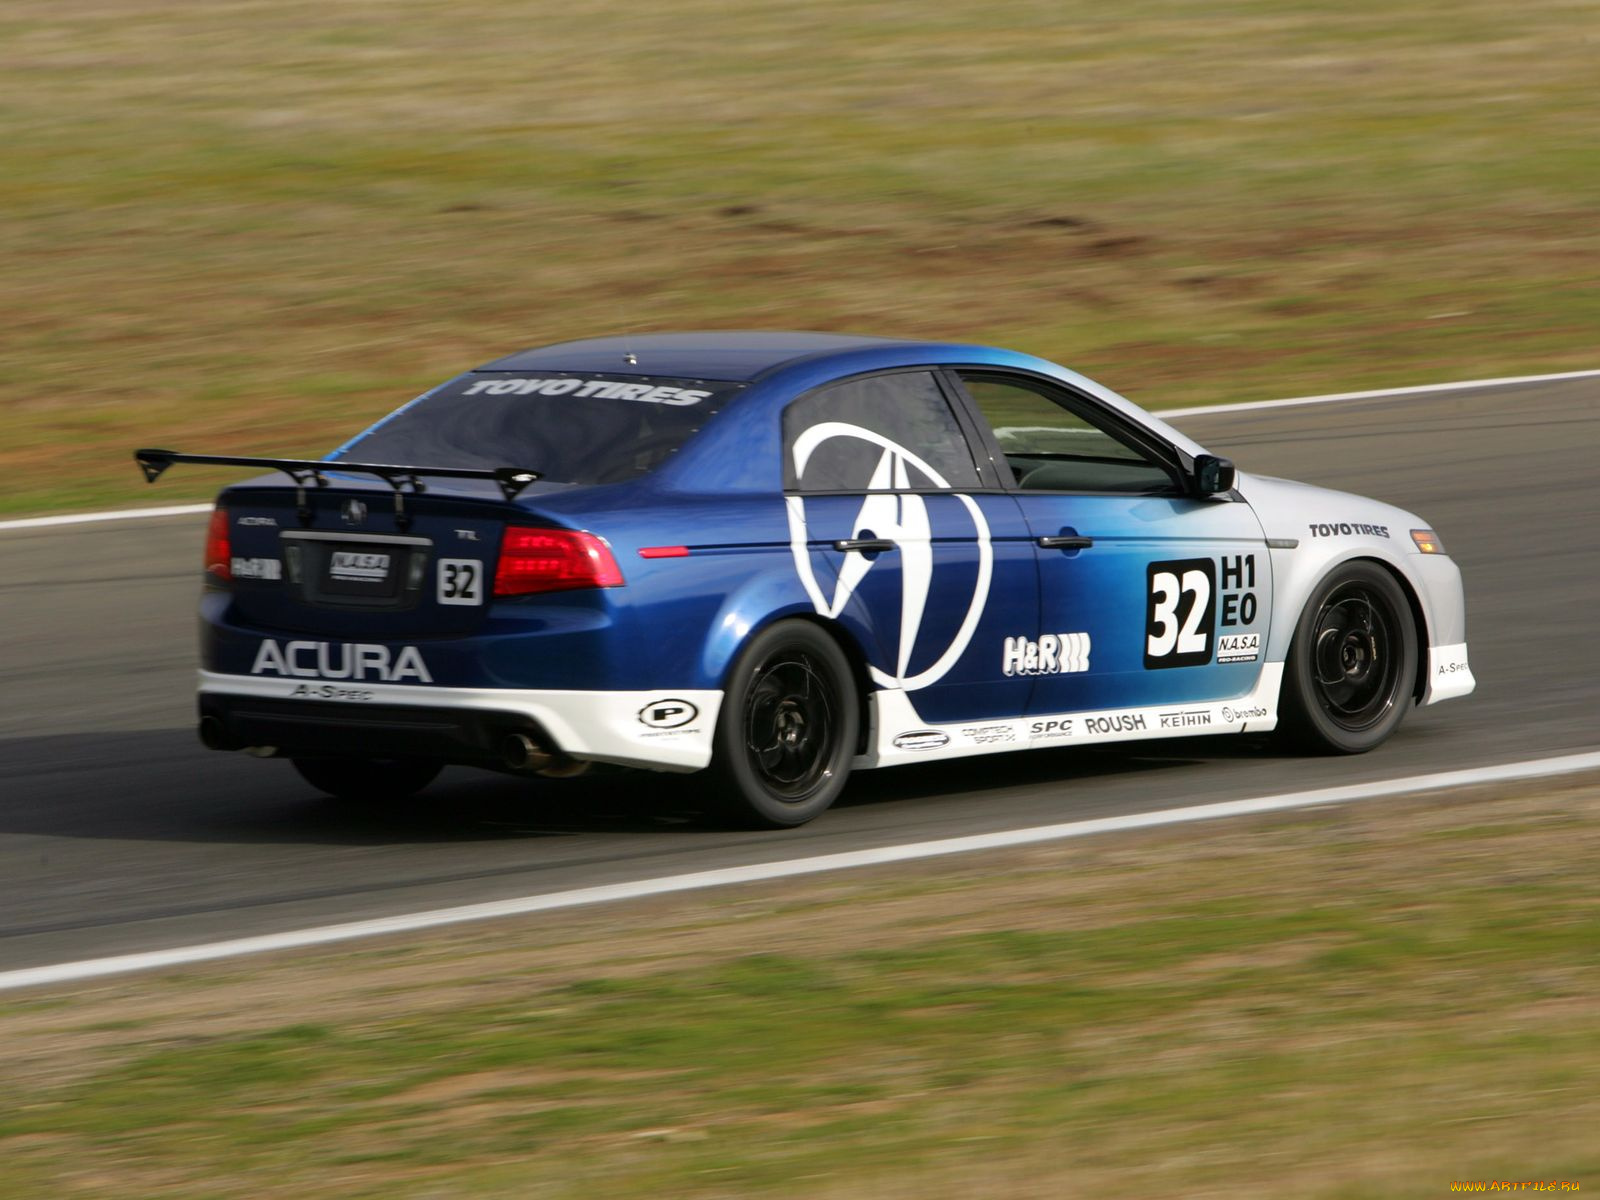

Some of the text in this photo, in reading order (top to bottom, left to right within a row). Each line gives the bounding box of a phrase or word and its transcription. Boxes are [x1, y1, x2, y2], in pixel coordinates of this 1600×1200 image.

[462, 379, 713, 406] TOYO TIRES
[1309, 523, 1390, 539] TOYO TIRES
[444, 563, 475, 599] 32
[1221, 554, 1255, 590] H1
[1147, 569, 1211, 657] 32
[251, 638, 434, 683] ACURA
[1003, 635, 1060, 676] H&R
[1085, 714, 1147, 735] ROUSH
[1160, 714, 1212, 729] KEIHIN
[1234, 706, 1268, 719] brembo
[1030, 719, 1073, 734] SPC
